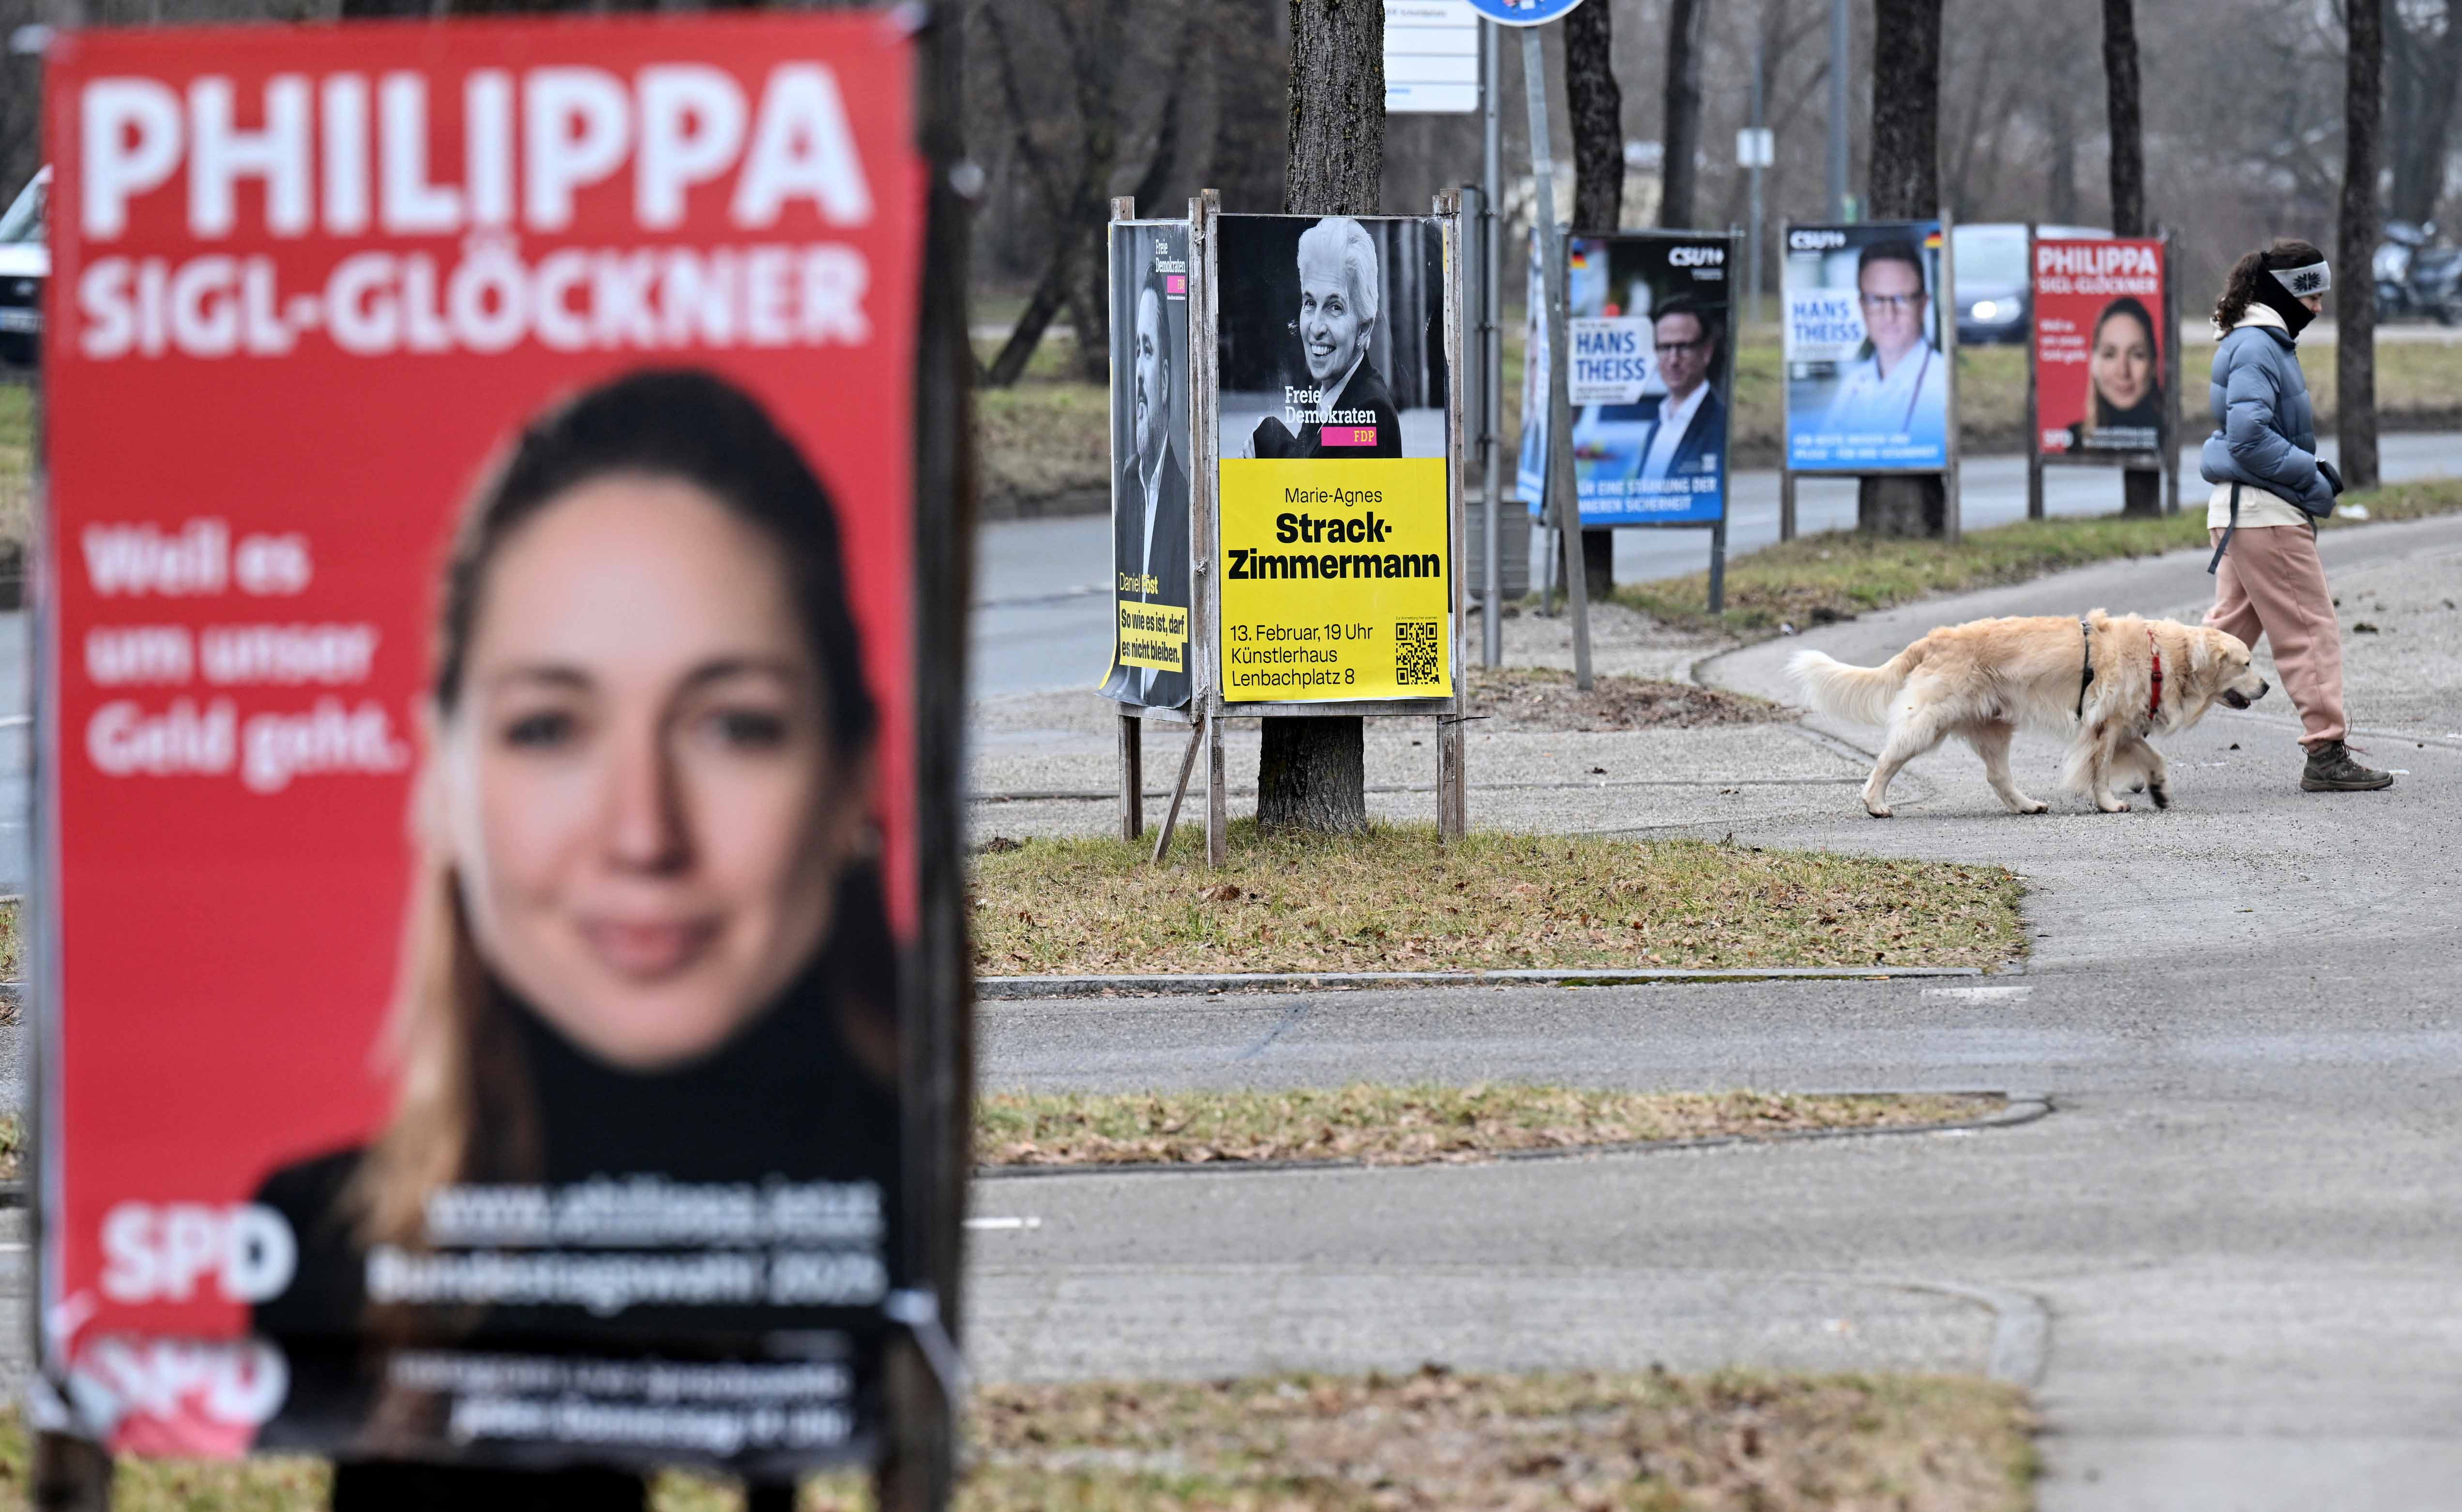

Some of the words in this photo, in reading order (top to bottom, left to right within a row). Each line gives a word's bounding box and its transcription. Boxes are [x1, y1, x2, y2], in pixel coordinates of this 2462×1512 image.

[79, 63, 874, 241] PHILIPPA
[1155, 238, 1168, 255] Freie
[1155, 256, 1185, 272] Demokraten
[2037, 246, 2158, 273] PHILIPPA
[2039, 275, 2157, 294] SIGL-GLÖCKNER
[76, 235, 871, 359] SIGL-GLÖCKNER
[1794, 300, 1850, 319] HANS
[1576, 331, 1635, 354] HANS
[1794, 322, 1860, 342] THEISS
[1576, 357, 1646, 380] THEISS
[1285, 385, 1321, 403] Freie
[1285, 405, 1376, 423] Demokraten
[1354, 430, 1374, 442] FDP
[1285, 487, 1383, 507] Marie-Agnes
[1577, 478, 1595, 497] ÜR
[1692, 476, 1717, 493] DER
[1276, 511, 1392, 544] Strack-
[81, 516, 231, 597] Weil
[232, 531, 314, 597] es
[1228, 548, 1440, 579] Zimmermann
[1119, 572, 1140, 592] Daniel
[1142, 575, 1158, 594] Föst
[1121, 609, 1131, 628] So
[1132, 609, 1145, 630] wie
[1146, 614, 1154, 632] es
[1156, 612, 1168, 636] ist,
[1169, 614, 1184, 635] darf
[1230, 625, 1252, 641] 13.
[1257, 624, 1320, 642] Februar,
[1324, 624, 1341, 640] 19
[1345, 623, 1373, 639] Uhr
[83, 622, 194, 686] um
[198, 621, 378, 686] unser
[1122, 641, 1131, 657] es
[1132, 638, 1150, 659] nicht
[1151, 640, 1180, 663] bleiben.
[1232, 646, 1338, 664] Künstlerhaus
[1232, 668, 1341, 689] Lenbachplatz
[1344, 668, 1355, 685] 8
[84, 696, 238, 776] Geld
[240, 696, 410, 794] geht.
[102, 1198, 298, 1304] SPD
[365, 1245, 762, 1317] Bundestagswahl
